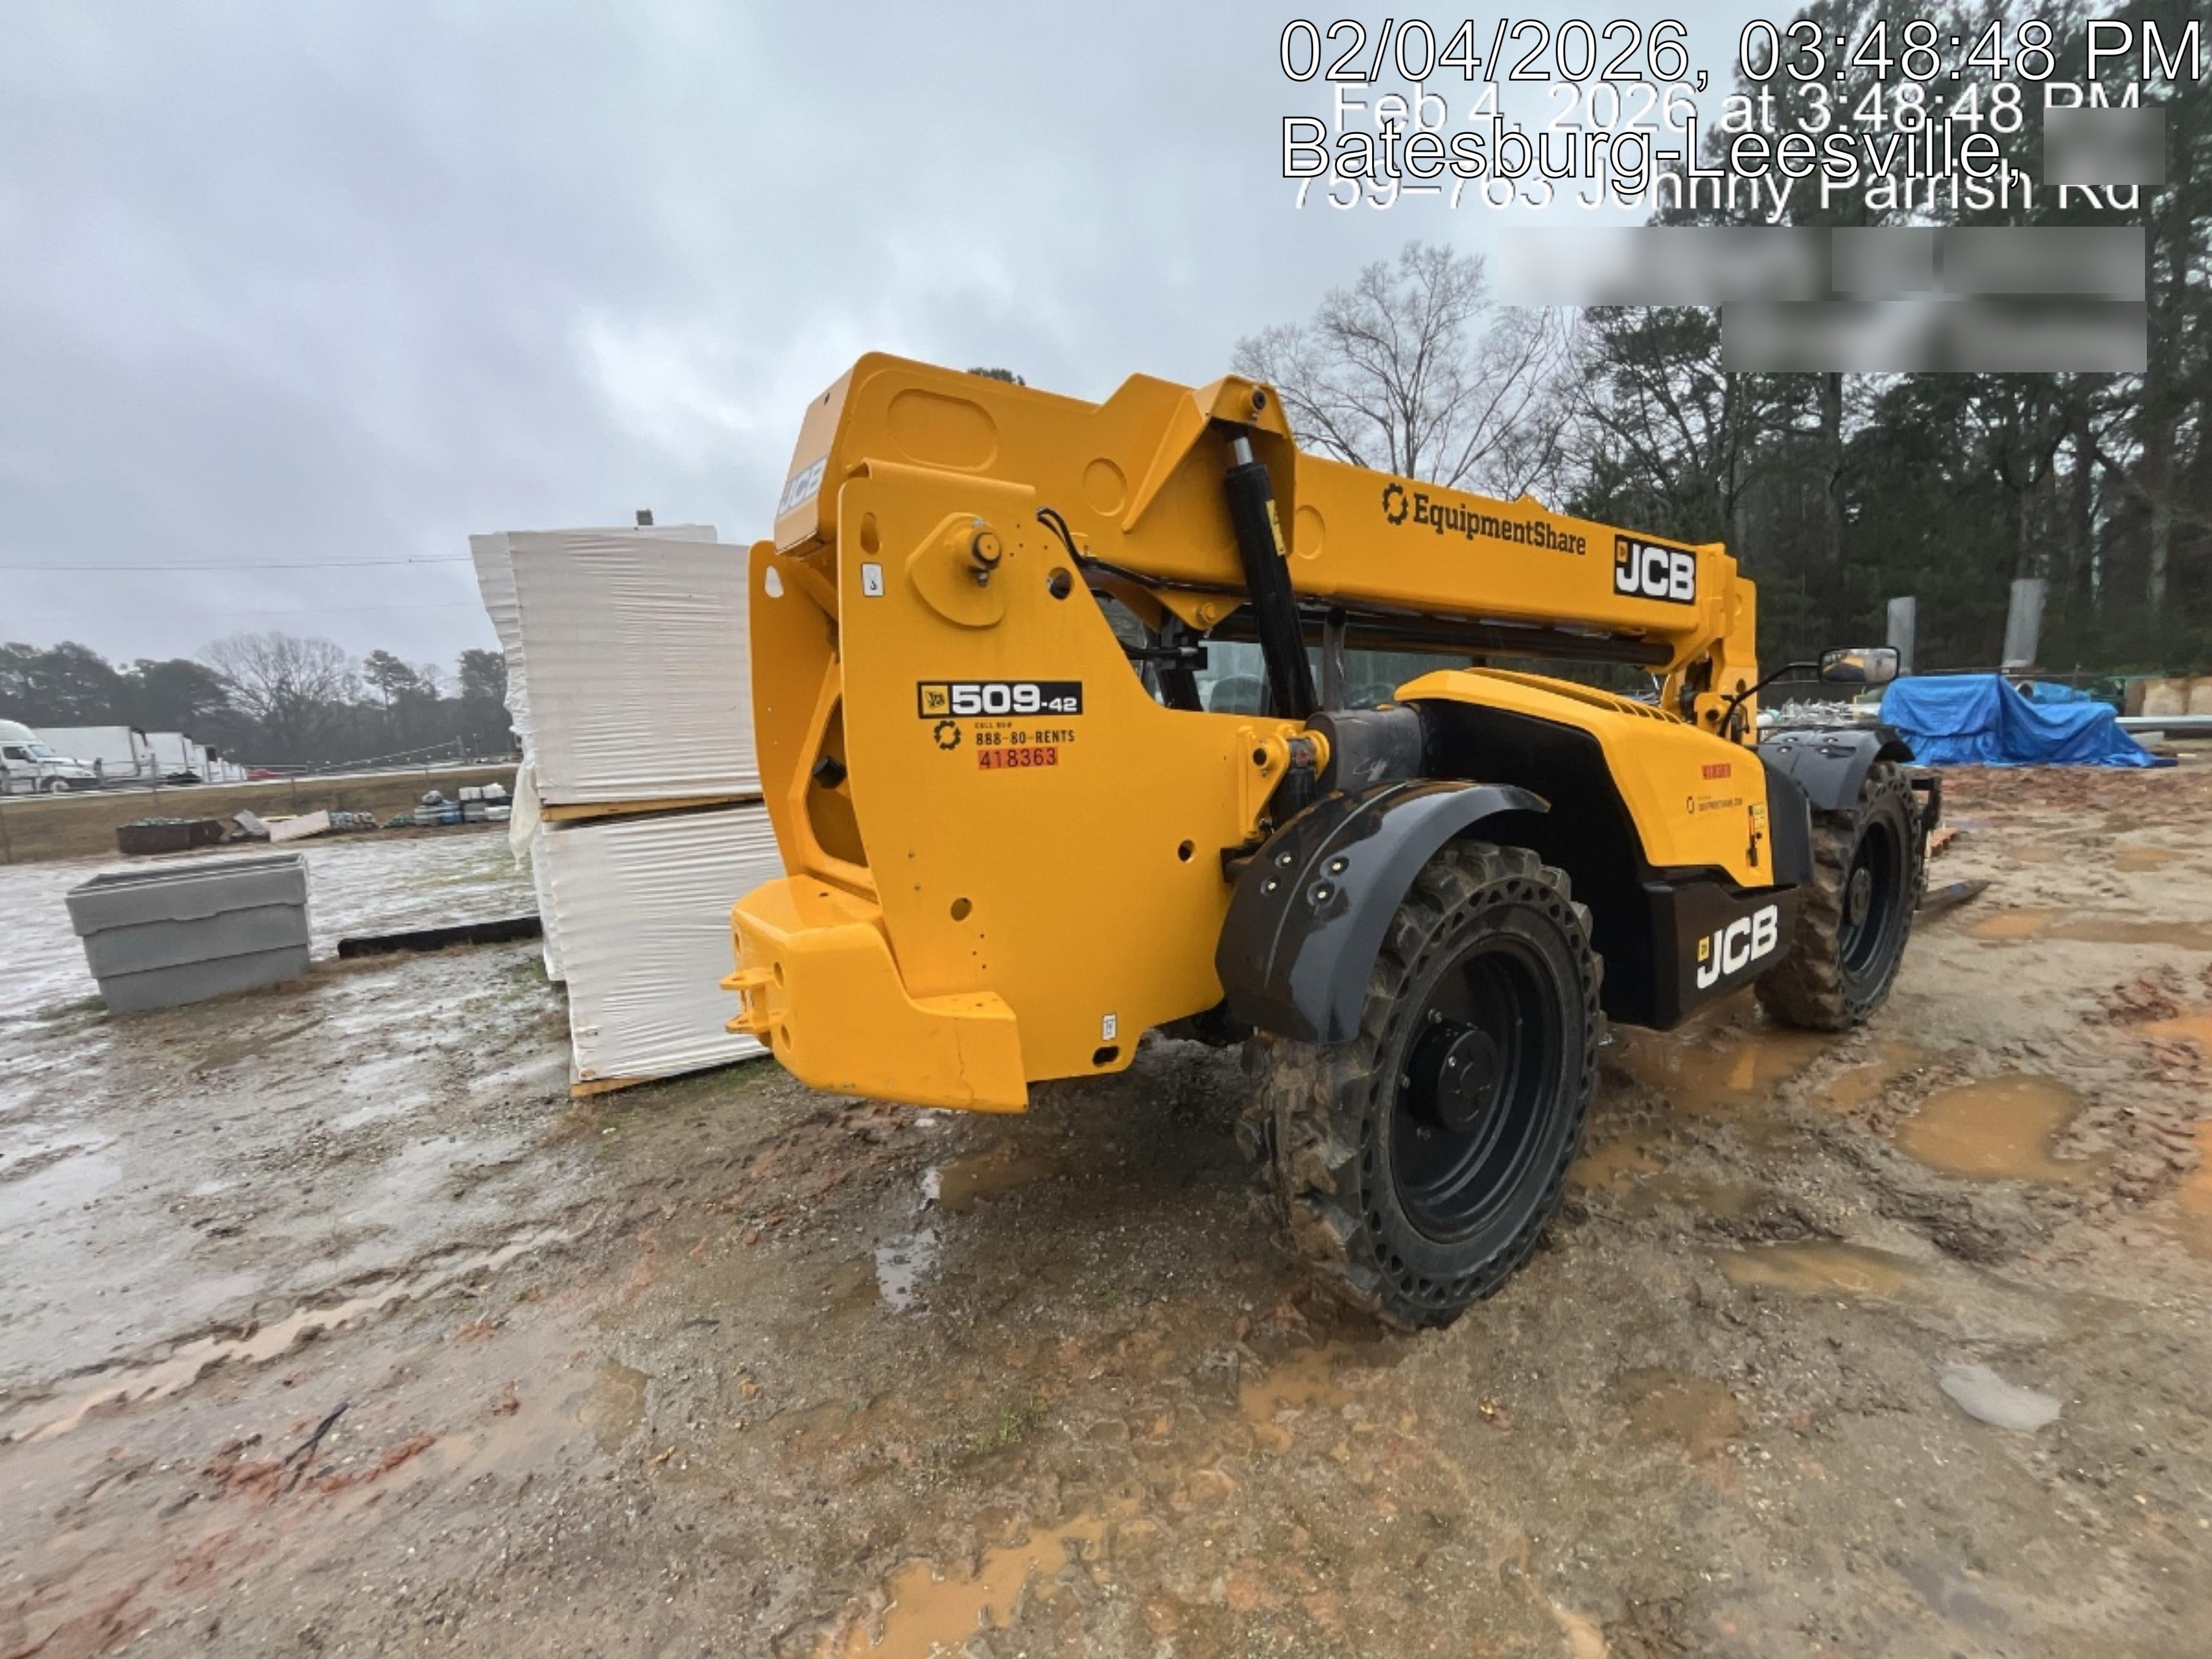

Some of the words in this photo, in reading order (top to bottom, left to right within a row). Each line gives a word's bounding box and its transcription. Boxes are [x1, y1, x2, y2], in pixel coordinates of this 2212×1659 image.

[1413, 493, 1587, 556] EquipmentShare
[1616, 543, 1695, 601] JCB
[952, 684, 1078, 715] 509-42
[976, 729, 1075, 745] 888-80-RENTS
[979, 747, 1056, 769] 418363
[1697, 904, 1778, 989] JCB
